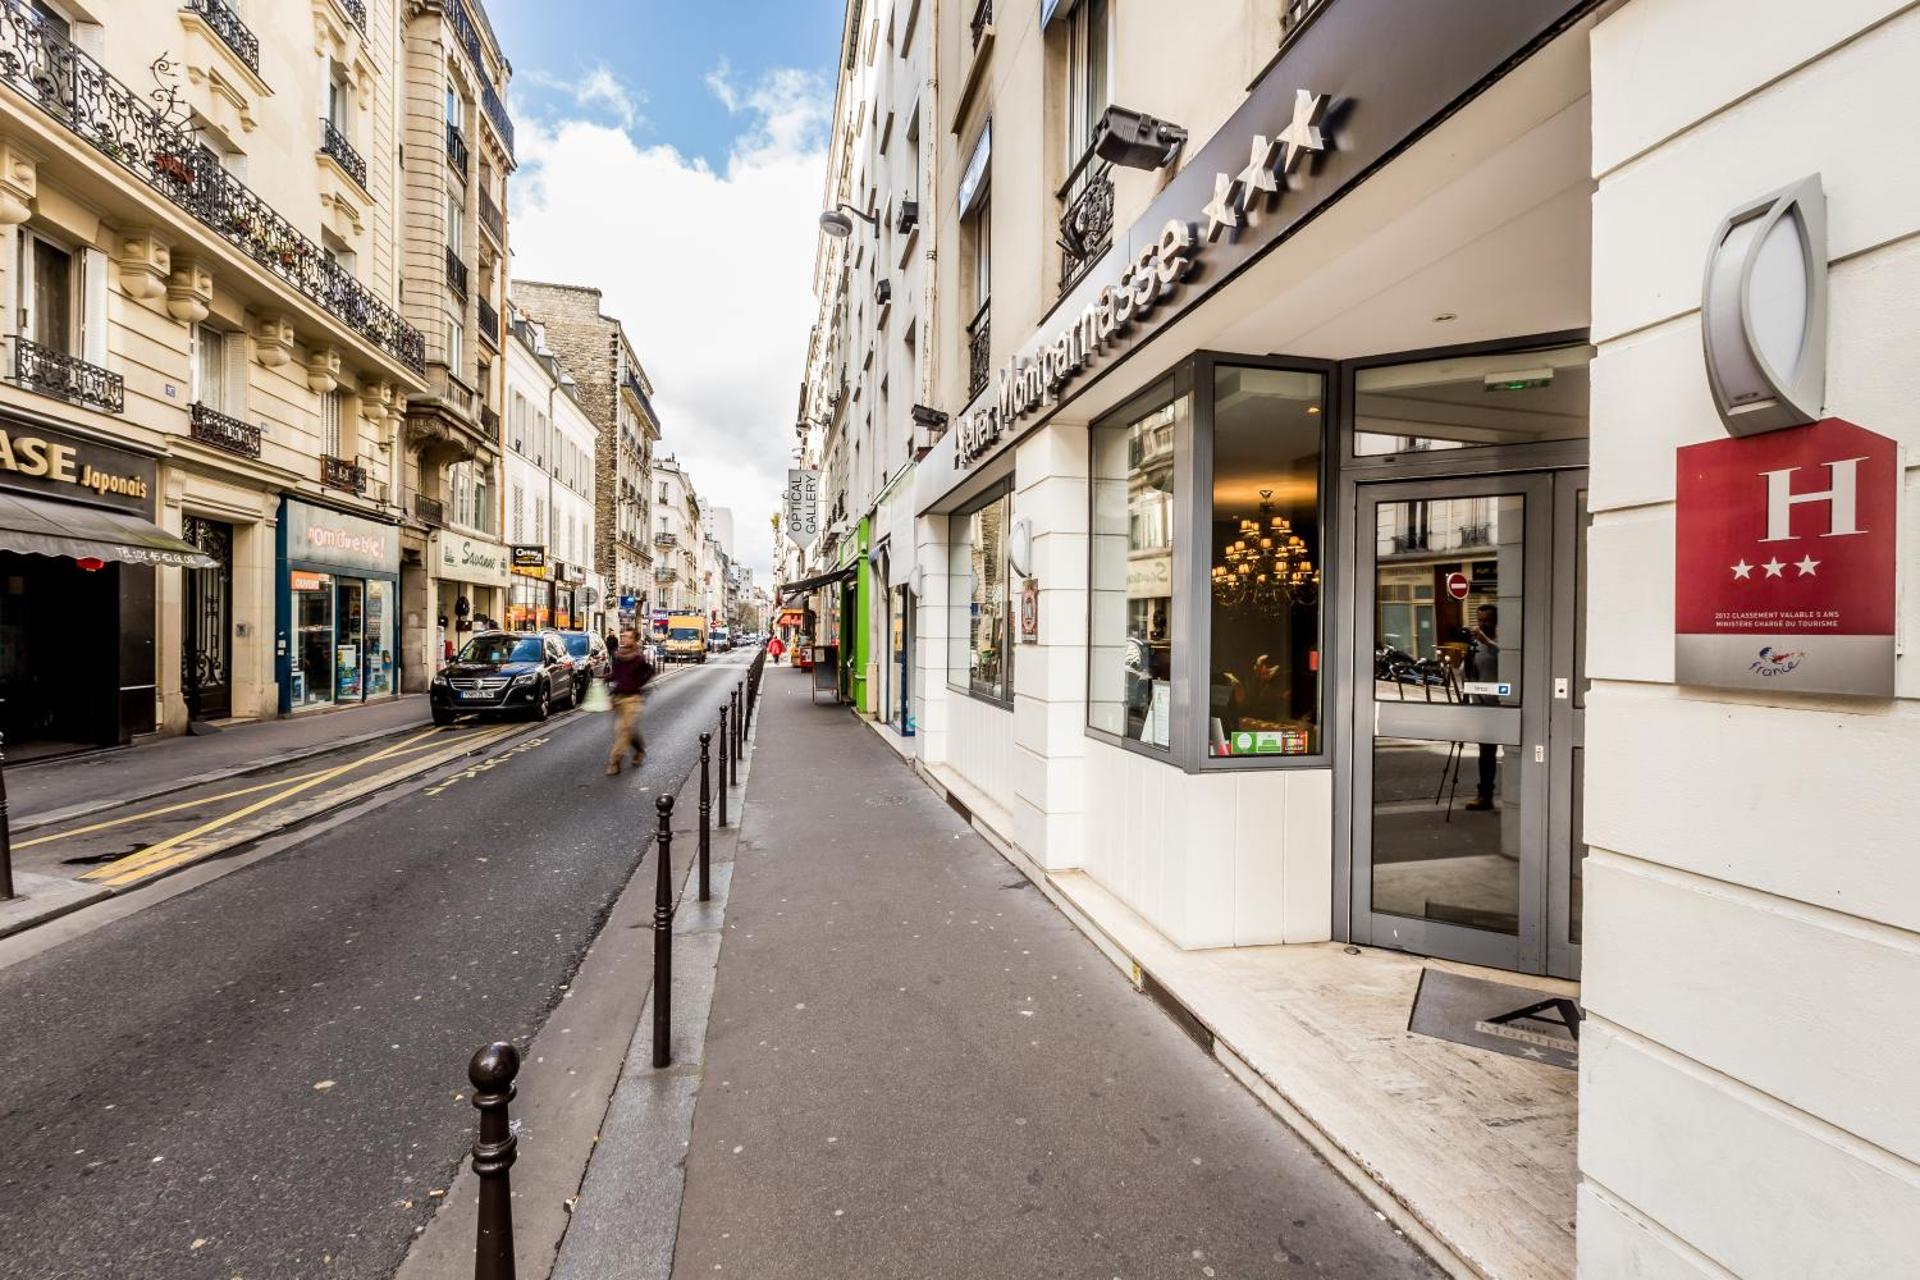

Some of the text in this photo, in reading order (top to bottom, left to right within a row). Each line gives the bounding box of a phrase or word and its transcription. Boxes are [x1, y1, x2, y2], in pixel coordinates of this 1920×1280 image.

[999, 218, 1193, 432] Montparnasse
[82, 465, 147, 498] Japonais
[791, 476, 802, 532] OPTICAL
[806, 474, 816, 535] GALLERY
[1757, 456, 1872, 543] H
